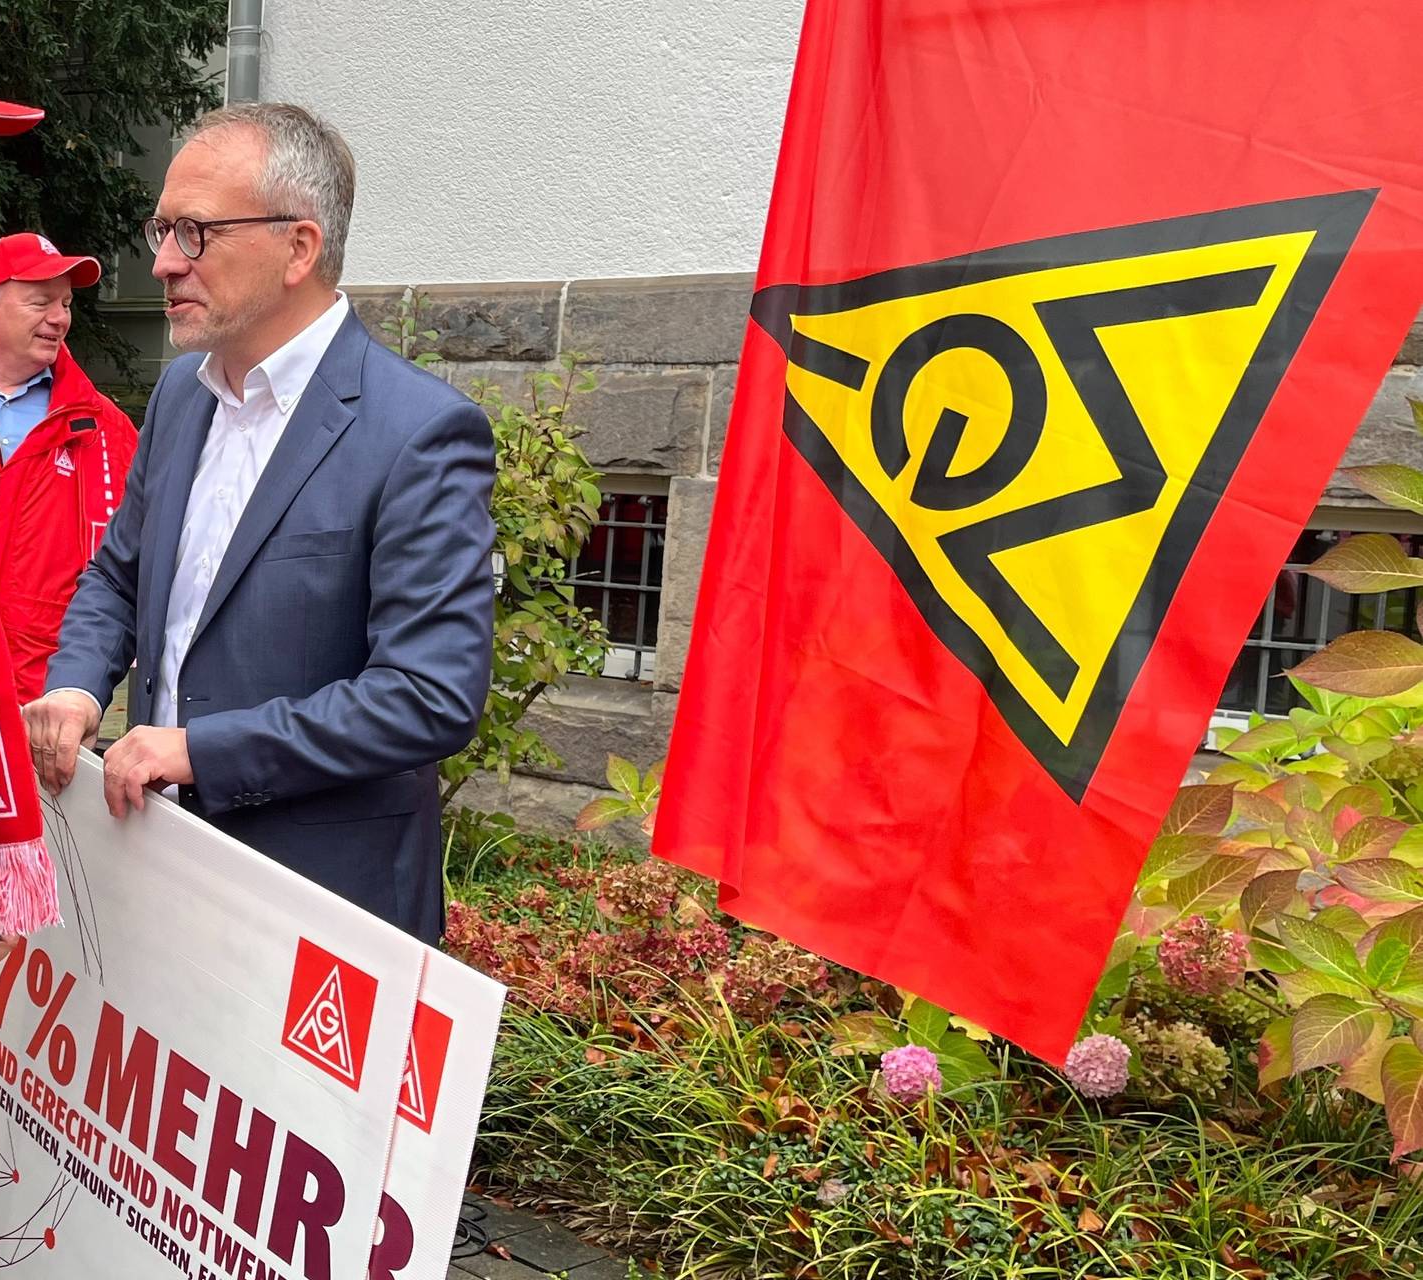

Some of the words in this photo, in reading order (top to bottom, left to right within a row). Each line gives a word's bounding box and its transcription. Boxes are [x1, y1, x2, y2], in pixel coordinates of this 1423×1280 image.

[295, 979, 351, 1071] IGM
[15, 1102, 61, 1167] DECKEN,
[63, 1149, 125, 1217] ZUKUNFT
[126, 1205, 193, 1280] SICHERN,
[20, 1067, 107, 1167] GERECHT
[108, 1143, 157, 1209] UND
[83, 1000, 345, 1280] MEHR
